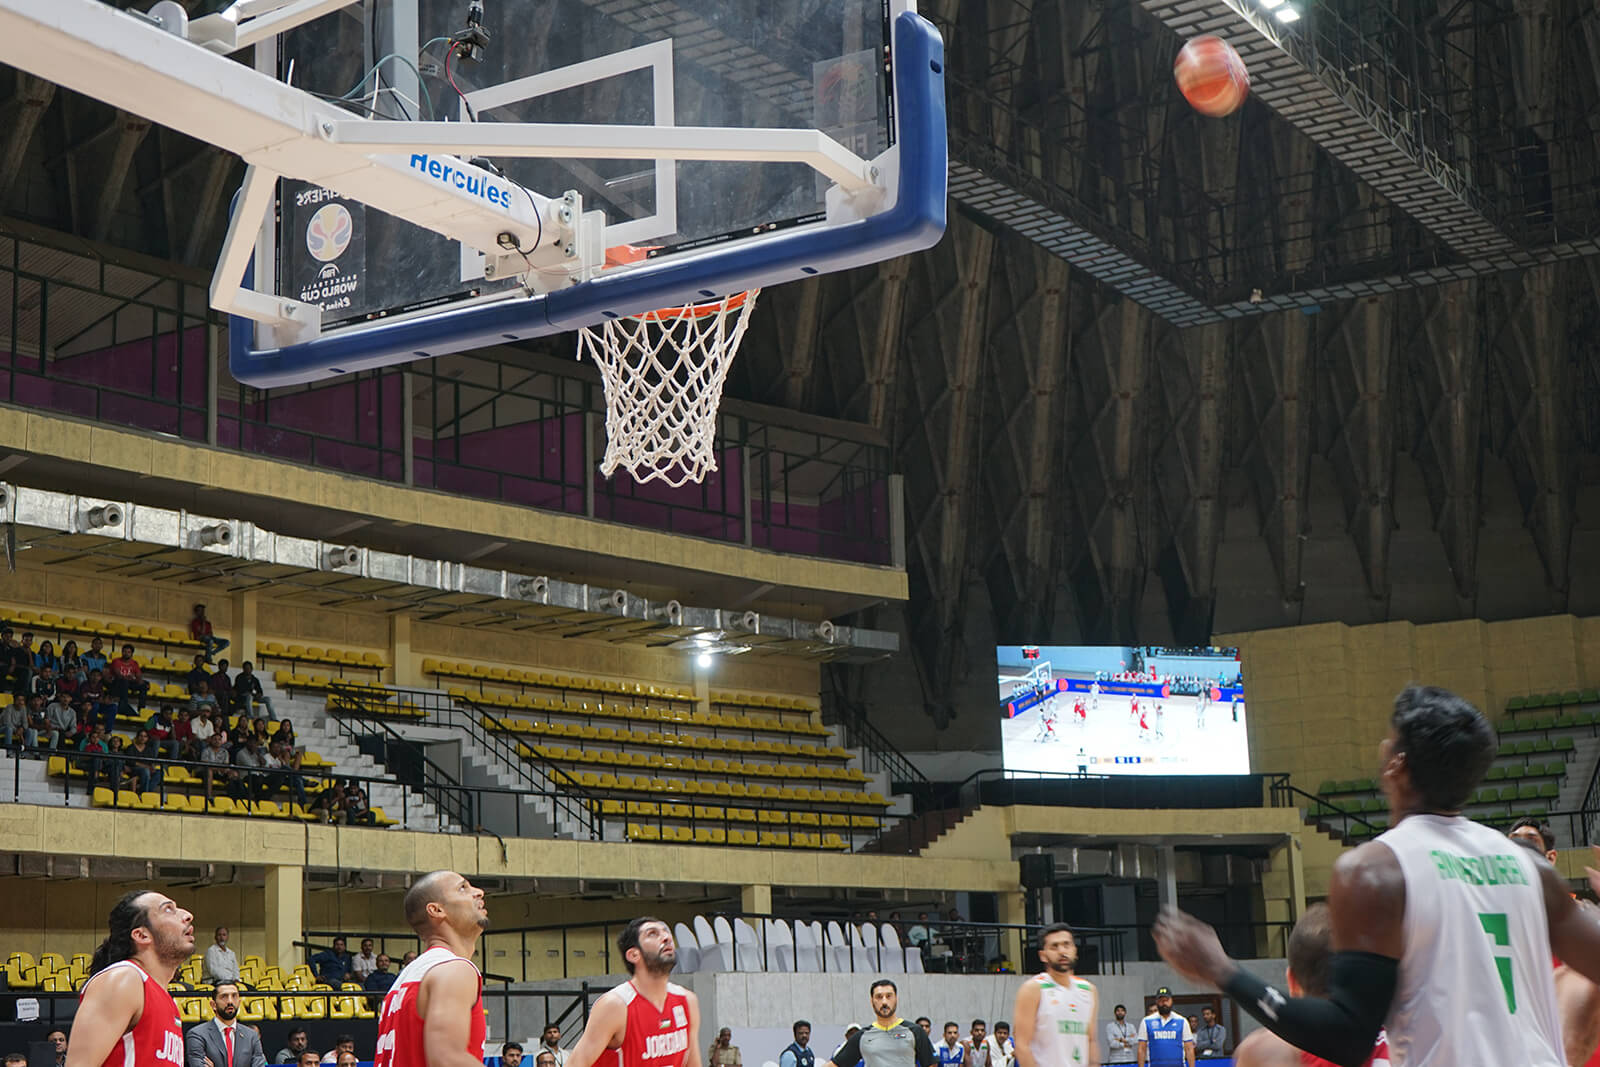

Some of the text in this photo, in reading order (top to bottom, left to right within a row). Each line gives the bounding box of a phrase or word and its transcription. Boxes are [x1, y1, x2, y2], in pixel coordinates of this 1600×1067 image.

[410, 153, 512, 208] Hercules
[641, 1028, 688, 1060] JORDAN
[1154, 1031, 1177, 1040] INDIA
